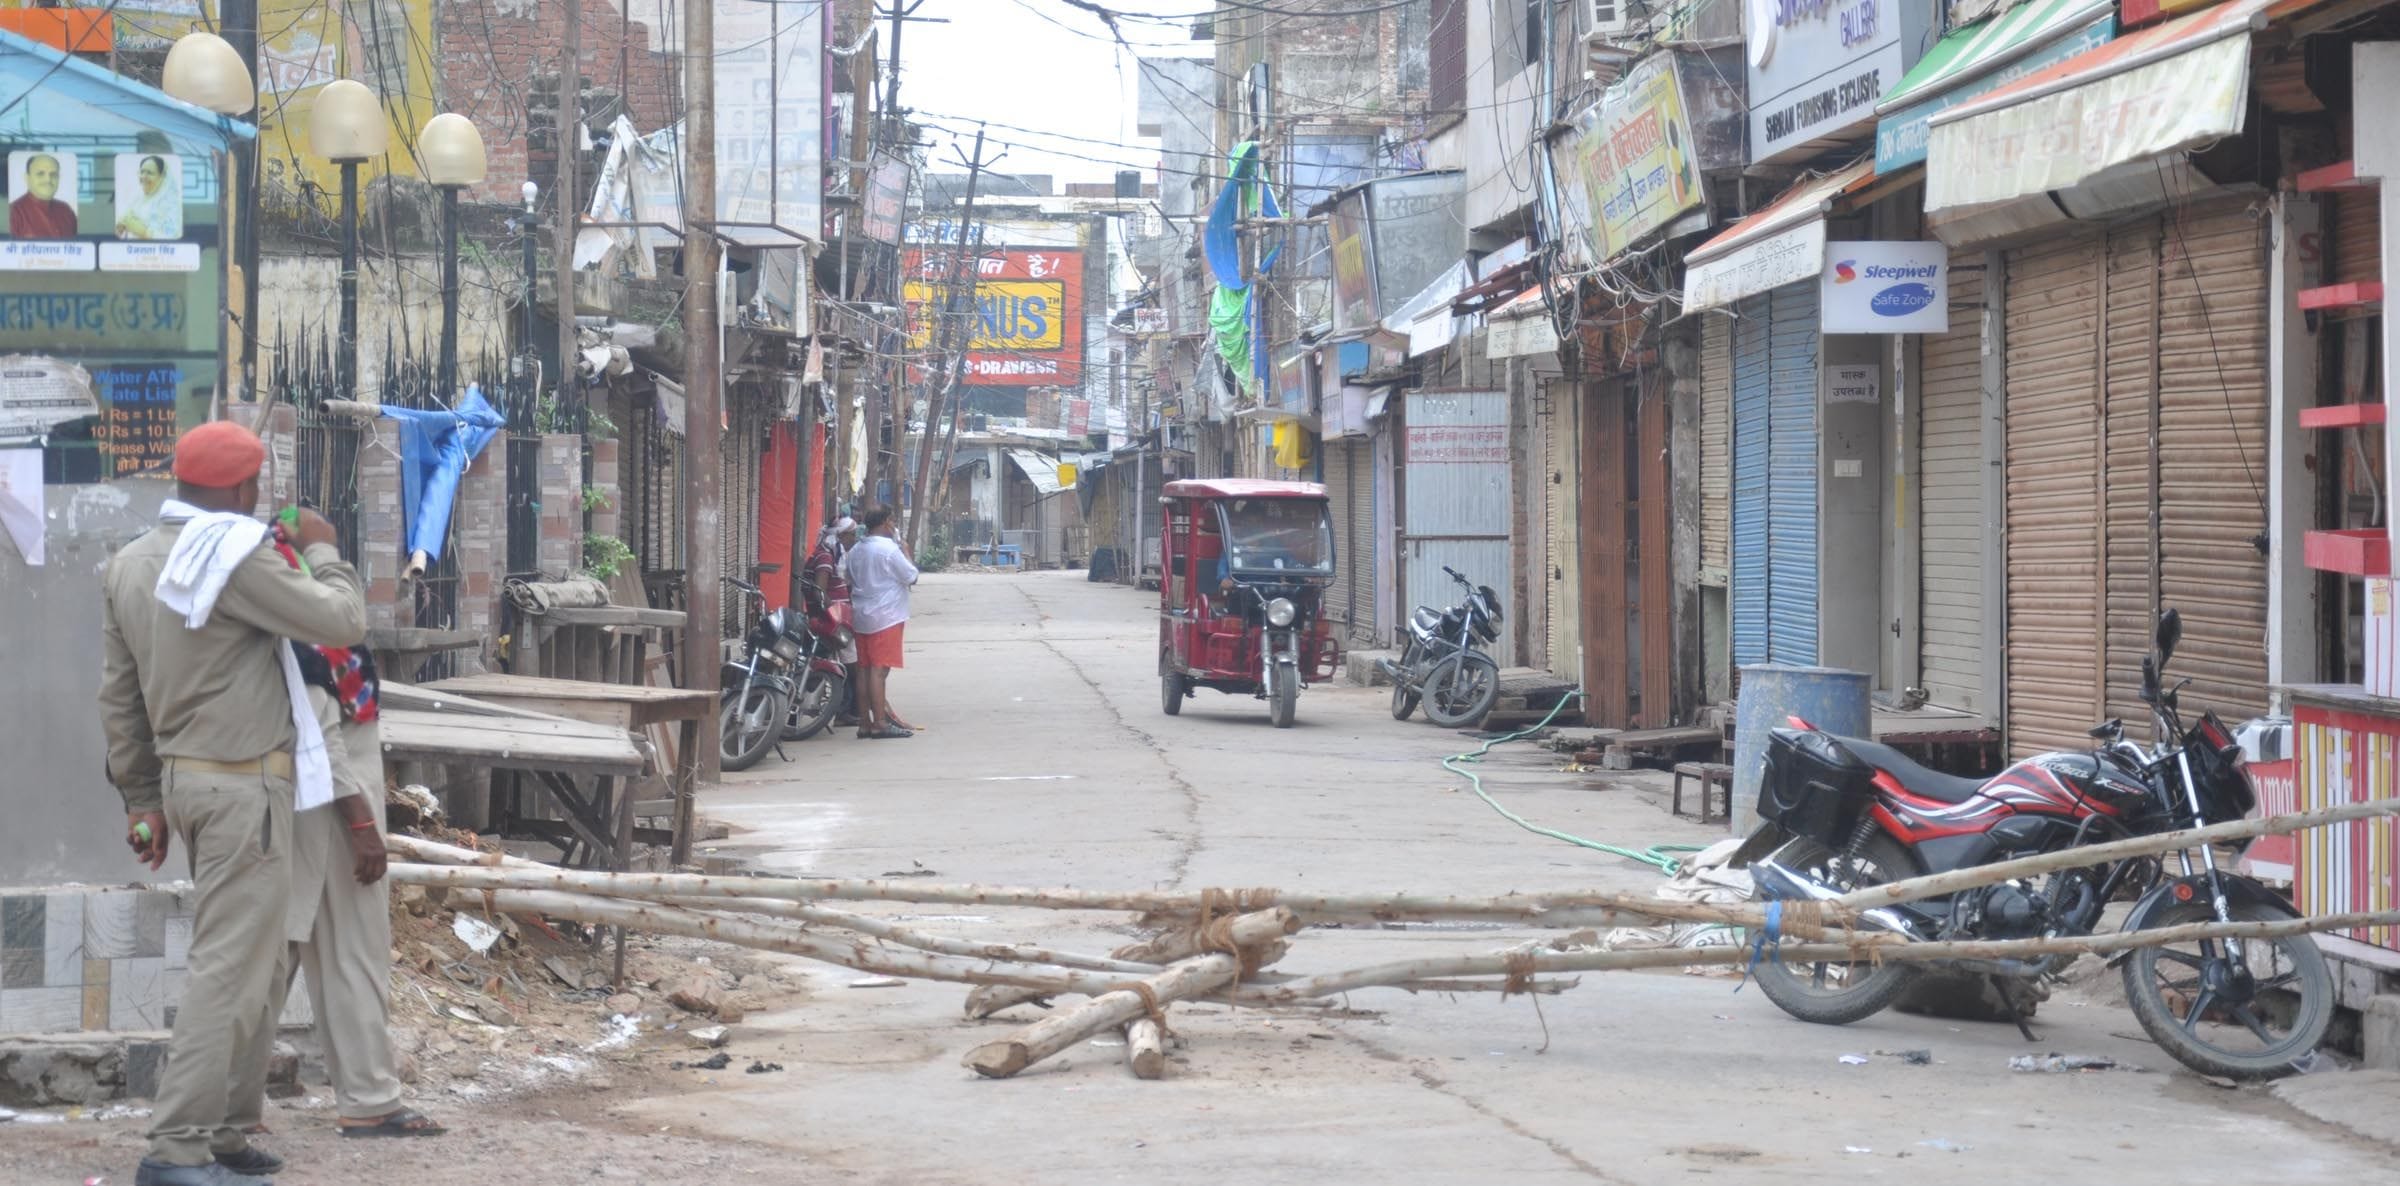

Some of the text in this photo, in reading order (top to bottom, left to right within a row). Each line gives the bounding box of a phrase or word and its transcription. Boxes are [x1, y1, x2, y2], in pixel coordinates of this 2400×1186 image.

[1796, 87, 1838, 131] FURNISHING
[1838, 68, 1881, 114] EXCLUSIVE
[1864, 264, 1938, 281] Sleepwell
[1872, 293, 1932, 307] Safe Zone
[94, 368, 184, 385] Water ATM
[1839, 369, 1867, 381] मास्क
[144, 386, 177, 401] List
[1867, 384, 1877, 398] है
[110, 408, 129, 421] Rs
[91, 425, 106, 439] 10
[110, 425, 129, 439] Rs
[147, 425, 164, 438] 10
[98, 442, 146, 455] Please
